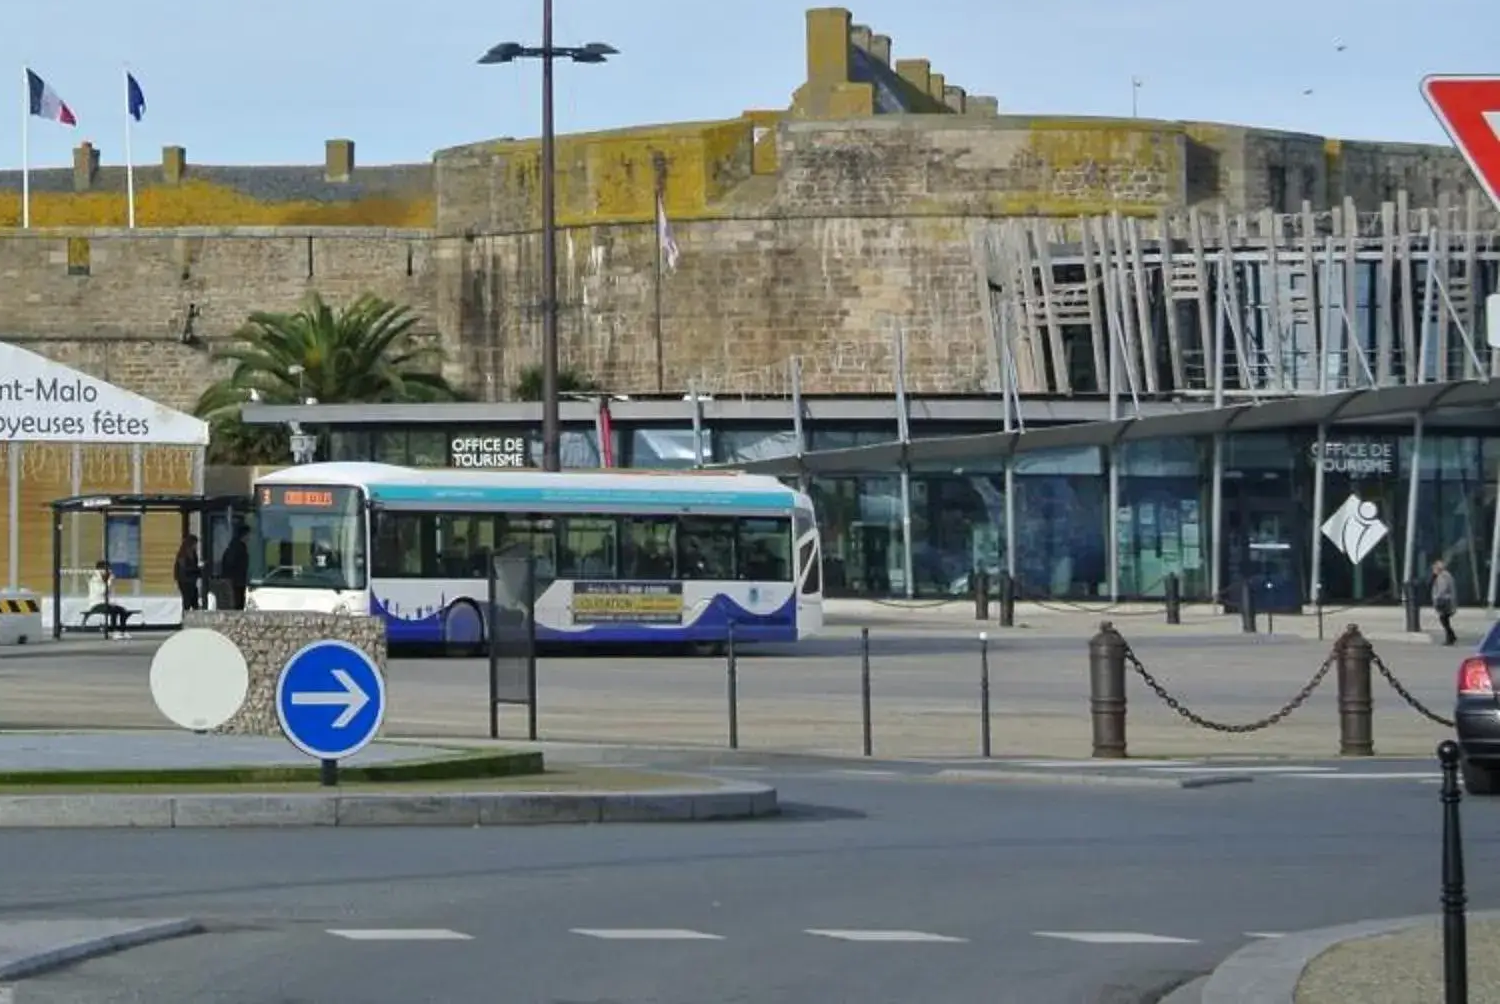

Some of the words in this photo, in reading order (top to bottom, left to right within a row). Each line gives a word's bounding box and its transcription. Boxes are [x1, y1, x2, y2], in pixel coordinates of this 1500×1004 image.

[92, 409, 149, 435] fêtes
[451, 438, 501, 452] OFFICE
[504, 438, 524, 452] DE
[1370, 443, 1392, 457] DE
[452, 453, 524, 467] TOURISME
[1312, 458, 1393, 473] OURISME
